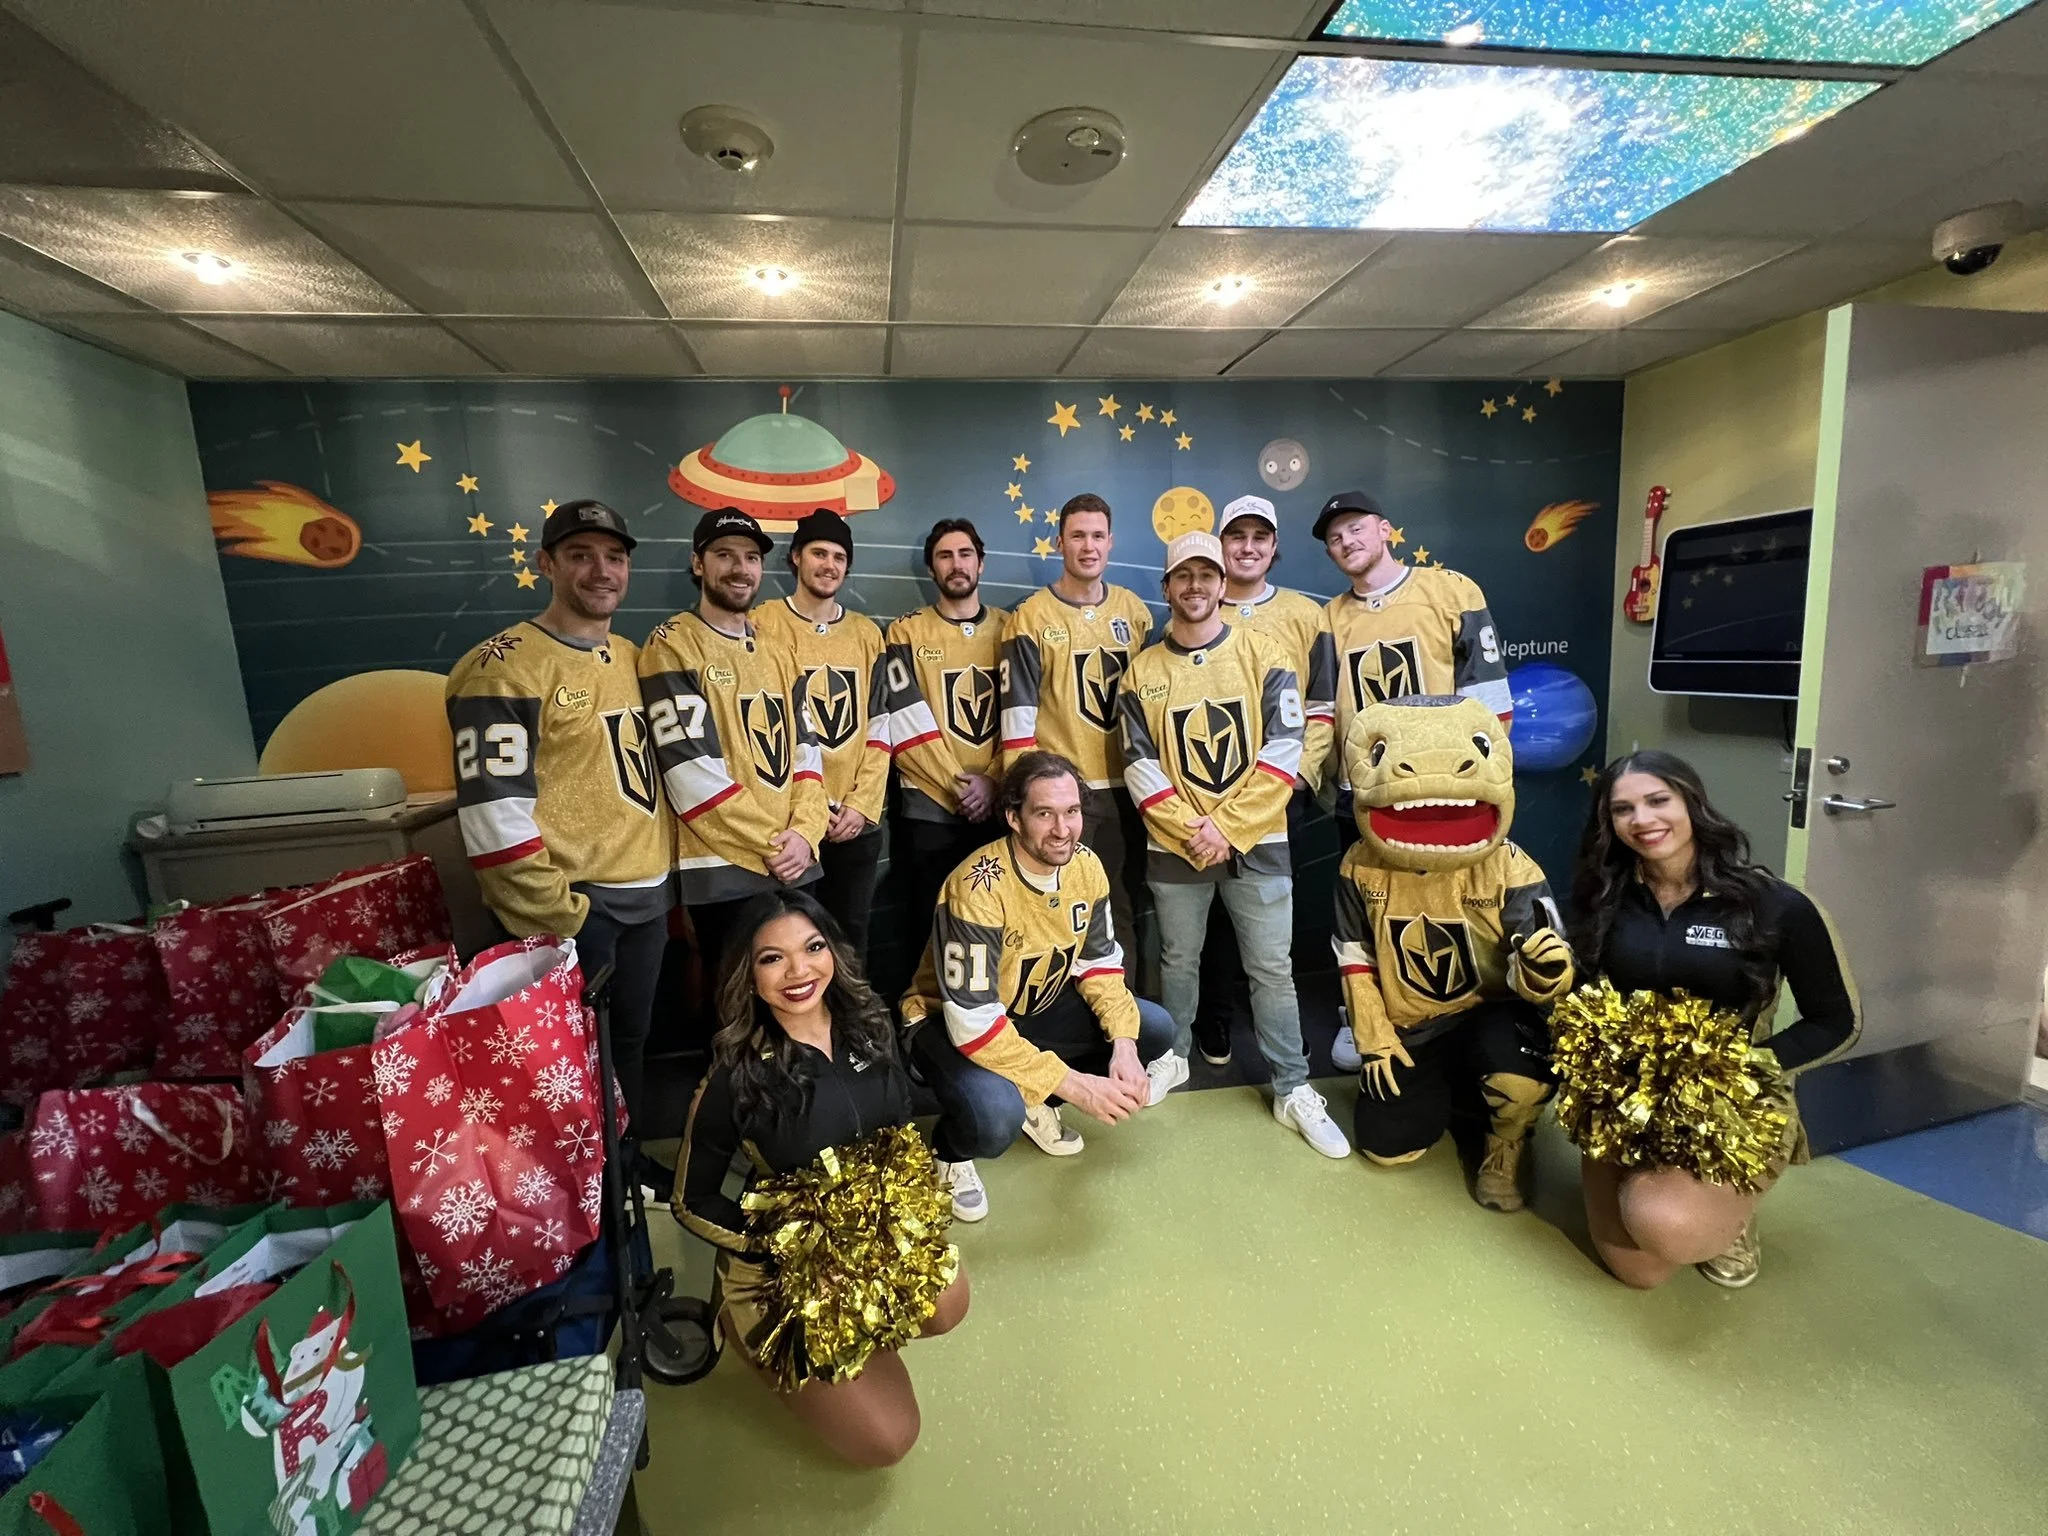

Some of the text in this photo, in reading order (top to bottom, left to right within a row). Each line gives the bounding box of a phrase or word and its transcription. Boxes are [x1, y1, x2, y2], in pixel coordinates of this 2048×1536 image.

[916, 645, 941, 658] Circa
[1500, 640, 1569, 661] Neptune
[555, 686, 589, 707] Circa
[1138, 684, 1168, 700] Circa
[650, 694, 708, 747] 27
[456, 723, 529, 780] 23
[1072, 902, 1088, 934] C
[944, 942, 990, 992] 61
